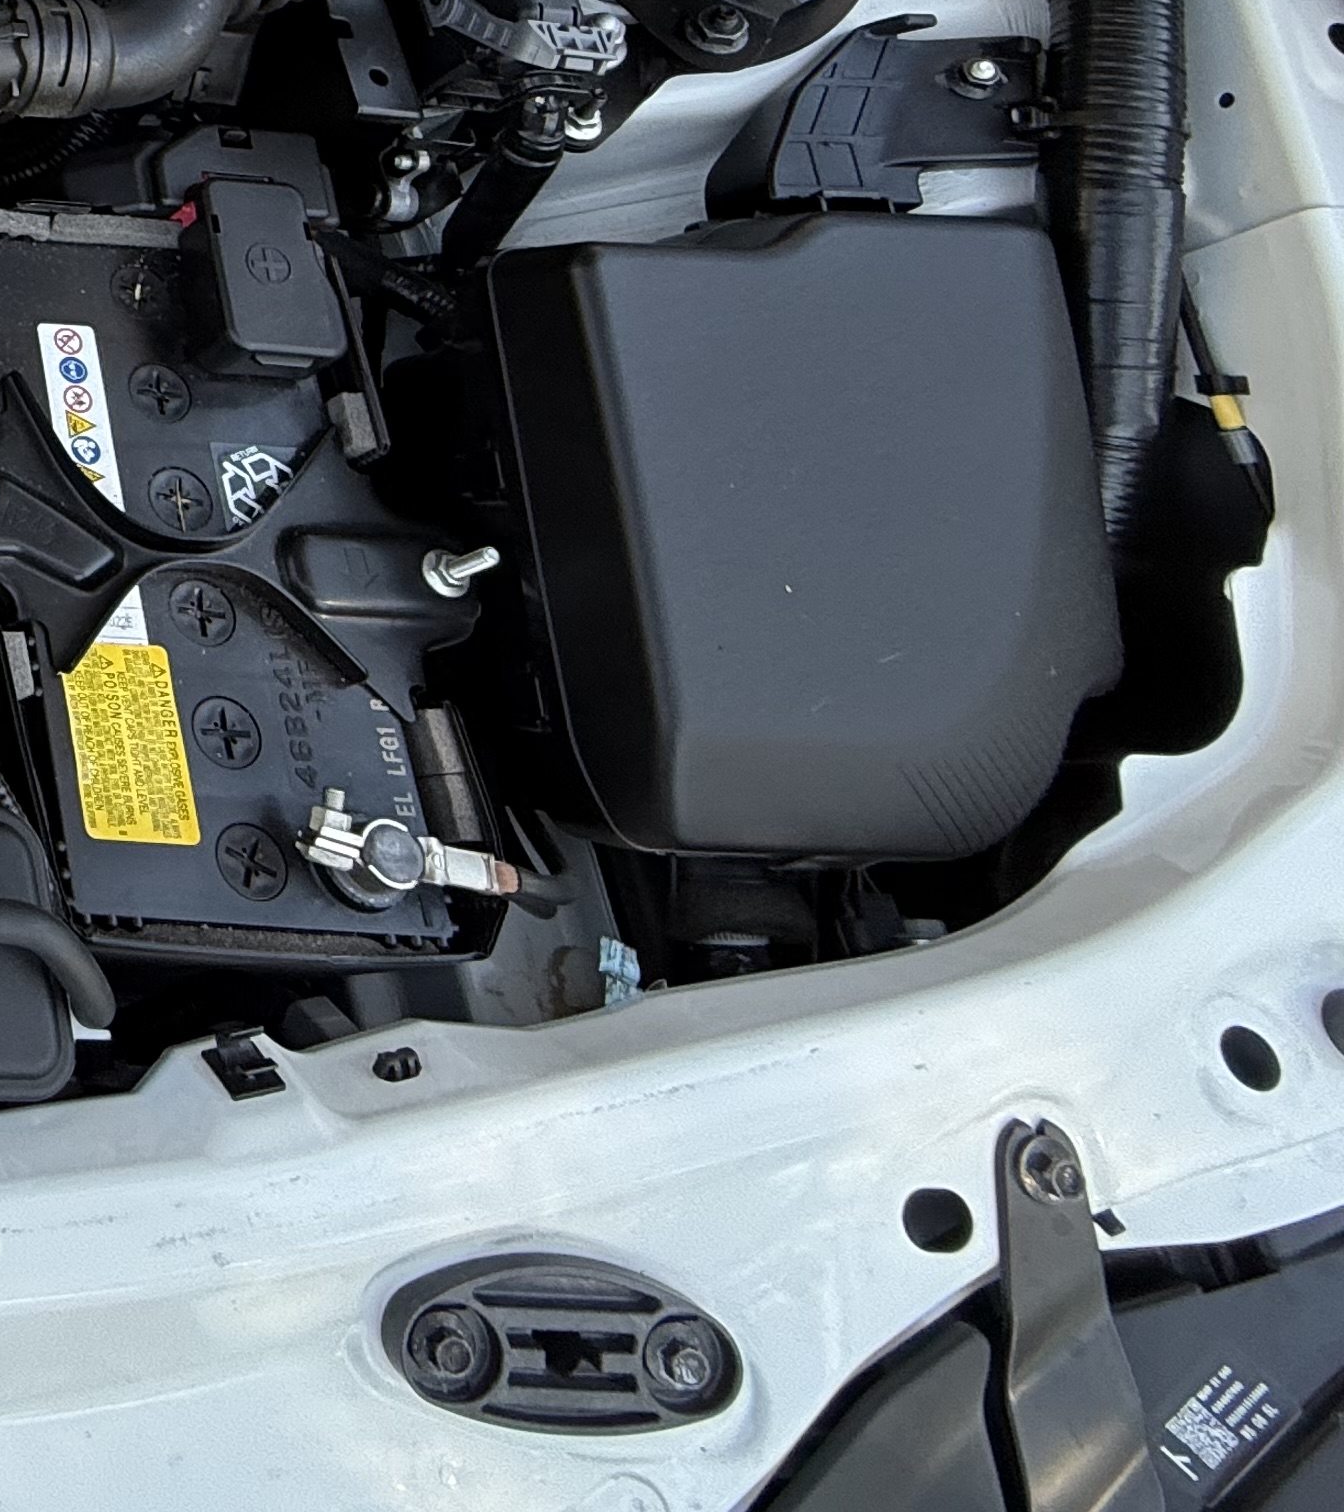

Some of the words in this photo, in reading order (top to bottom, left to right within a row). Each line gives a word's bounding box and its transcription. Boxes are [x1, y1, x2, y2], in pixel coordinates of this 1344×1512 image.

[74, 670, 85, 691] KEEP
[116, 670, 129, 693] KEEP
[77, 692, 88, 710] OUT
[102, 671, 123, 721] POISON
[121, 694, 133, 716] VENT
[155, 679, 178, 739] DANGER
[80, 710, 91, 724] OF
[125, 717, 137, 740] CAPS
[82, 724, 96, 753] REACH
[111, 721, 126, 757] CAUSES
[88, 754, 98, 769] OF
[129, 742, 142, 769] TIGHT
[166, 740, 185, 789] EXPLOSIVE
[117, 758, 132, 793] SEVERE
[133, 768, 145, 788] AND
[89, 768, 105, 811] CHILDREN
[136, 788, 150, 815] LEVEL
[123, 794, 137, 826] BURNS
[175, 789, 191, 822] GASES
[393, 792, 416, 818] EL
